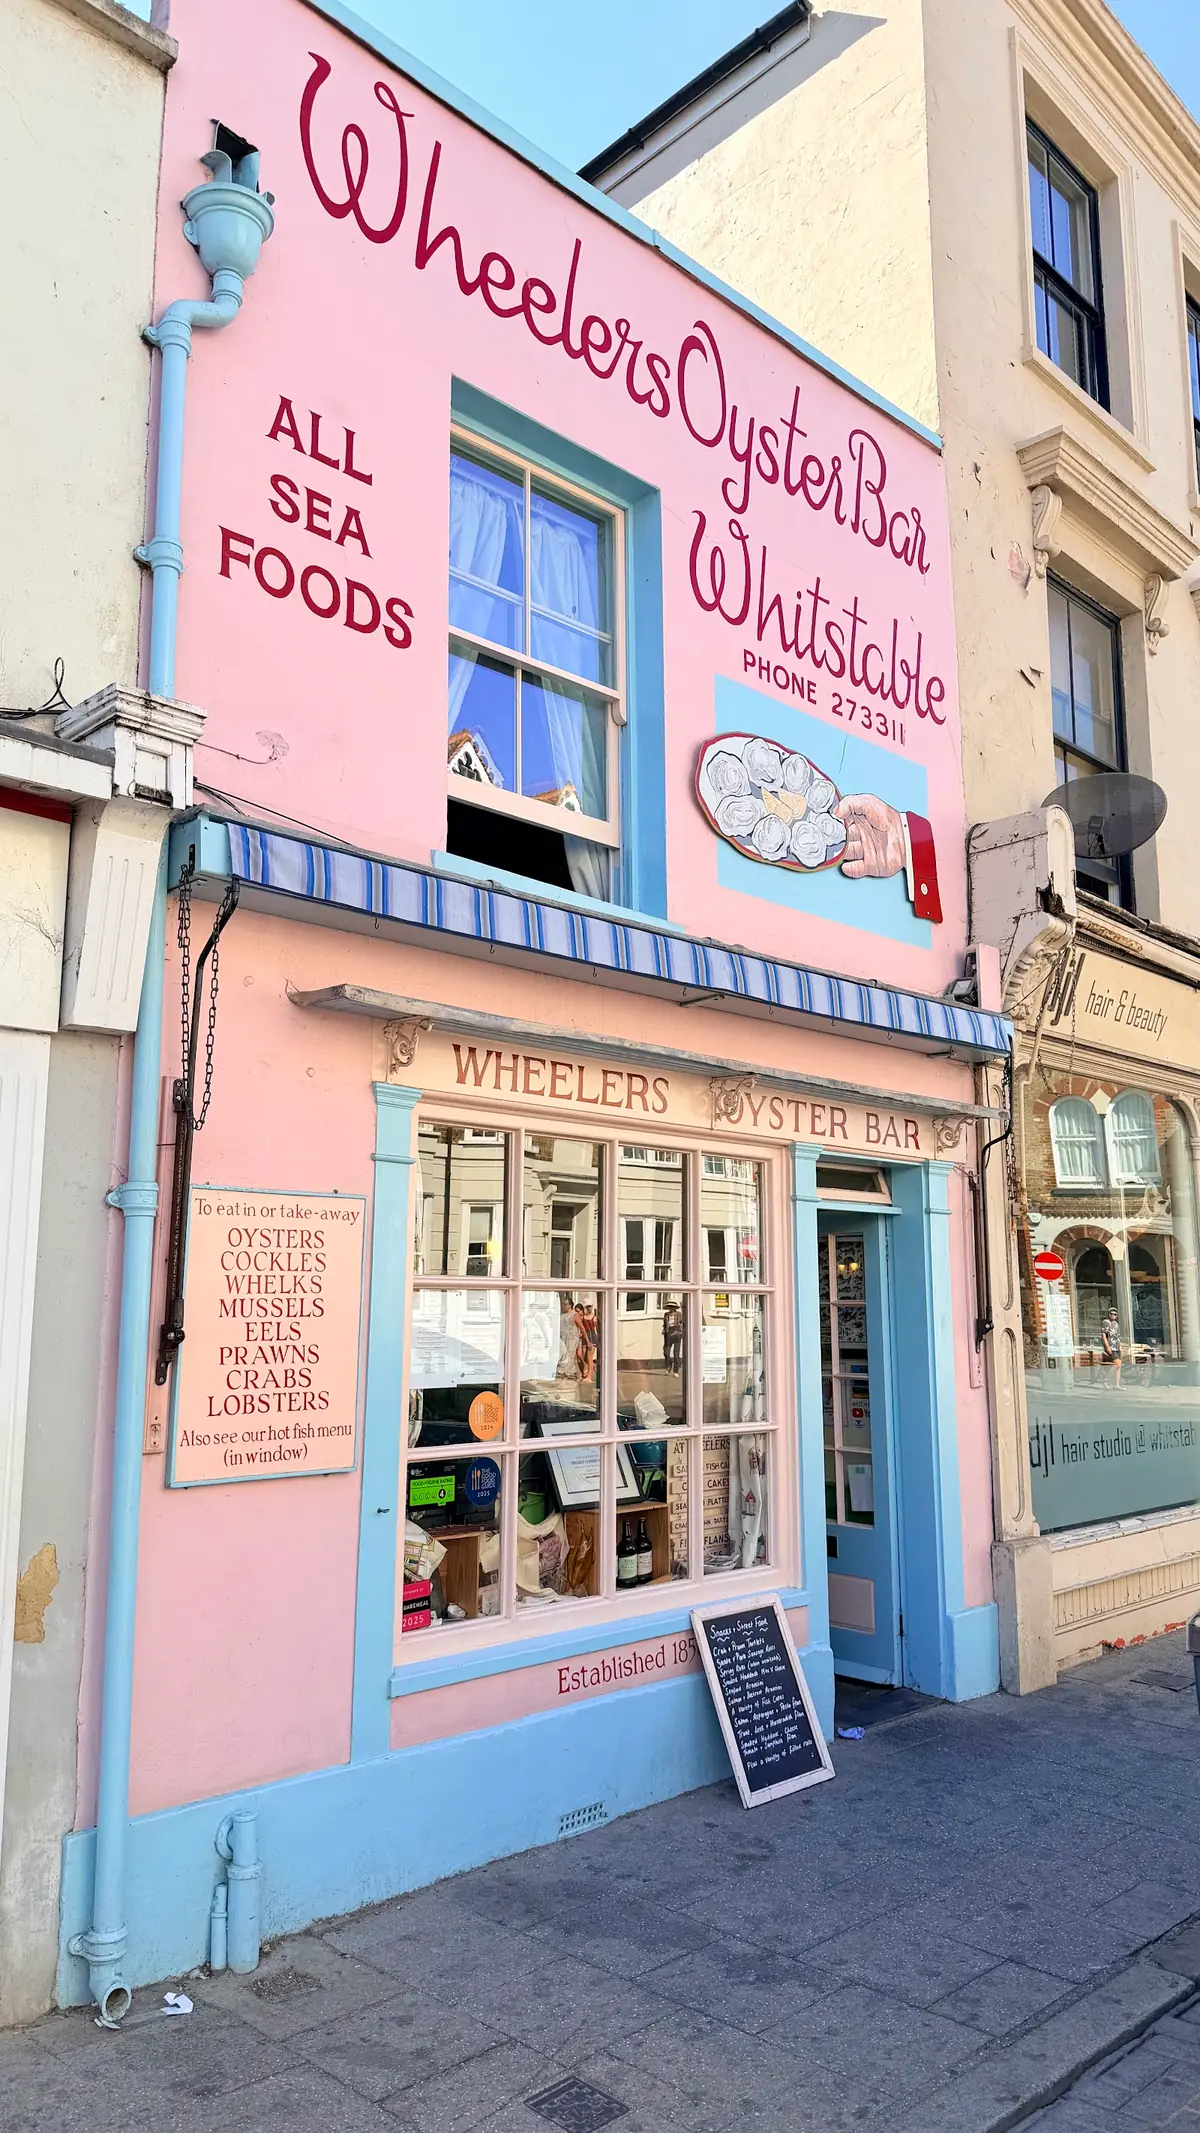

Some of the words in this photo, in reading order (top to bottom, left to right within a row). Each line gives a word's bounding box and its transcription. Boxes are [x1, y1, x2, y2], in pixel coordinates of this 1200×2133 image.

[298, 51, 670, 418] Wheelers
[677, 319, 847, 515] Oyster
[848, 428, 931, 575] Bar
[265, 394, 373, 486] ALL
[268, 473, 375, 560] SEA
[216, 524, 415, 650] FOODS
[689, 509, 946, 726] Whitstable
[743, 648, 817, 705] PHONE
[831, 692, 907, 747] 273311
[1084, 979, 1114, 1018] hair
[1114, 990, 1128, 1022] &
[1125, 993, 1168, 1042] beauty
[452, 1043, 670, 1114] WHEELERS
[865, 1111, 921, 1150] BAR
[195, 1198, 212, 1215] To
[216, 1203, 240, 1216] eat
[243, 1203, 256, 1217] in
[260, 1205, 277, 1218] or
[280, 1204, 360, 1226] take-away
[228, 1227, 325, 1249] OYSTERS
[221, 1250, 327, 1272] COCKLES
[224, 1274, 322, 1294] WHELKS
[218, 1298, 324, 1318] MUSSELS
[245, 1321, 302, 1342] EELS
[219, 1344, 320, 1366] PRAWNS
[226, 1368, 312, 1390] CRABS
[207, 1390, 330, 1417] LOBSTERS
[180, 1429, 211, 1447] Also
[213, 1431, 238, 1444] see
[241, 1430, 266, 1443] our
[268, 1425, 290, 1441] hot
[293, 1422, 315, 1439] fish
[317, 1423, 352, 1437] menu
[673, 1442, 685, 1454] AT
[703, 1438, 730, 1451] EELERS
[1029, 1415, 1055, 1478] djl
[1061, 1433, 1089, 1464] hair
[1094, 1427, 1131, 1459] studio
[1135, 1424, 1146, 1454] @
[223, 1448, 243, 1468] (in
[245, 1443, 308, 1464] window)
[705, 1462, 719, 1471] FISH
[704, 1533, 729, 1545] FLANS
[402, 1614, 424, 1628] 2025
[710, 1625, 732, 1639] Snacks
[737, 1620, 753, 1631] Street
[755, 1616, 768, 1628] Food
[557, 1643, 665, 1695] Established
[672, 1637, 701, 1665] 185
[720, 1668, 735, 1678] Spring
